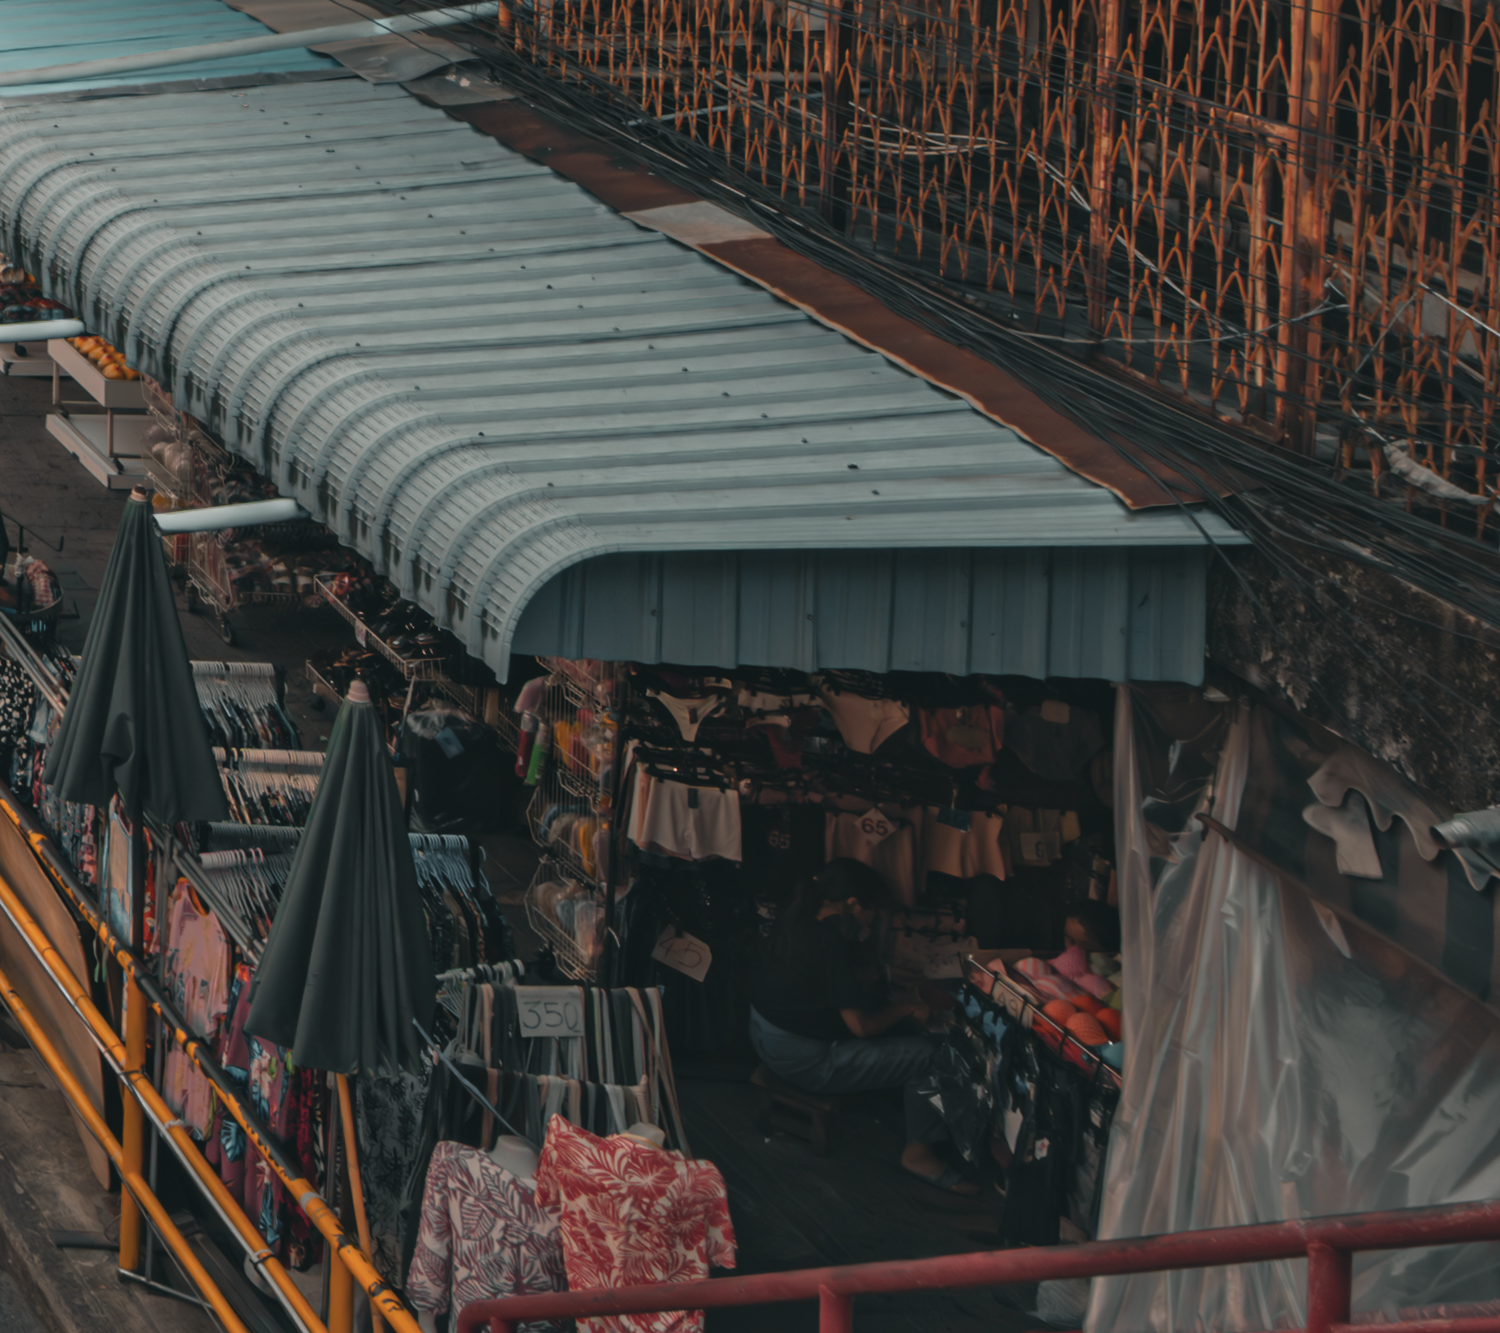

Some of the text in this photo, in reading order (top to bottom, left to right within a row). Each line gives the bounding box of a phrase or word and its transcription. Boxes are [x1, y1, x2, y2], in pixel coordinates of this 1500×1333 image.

[862, 817, 889, 837] 65
[768, 830, 791, 850] 65
[658, 935, 704, 970] 45
[522, 1000, 577, 1031] 350
